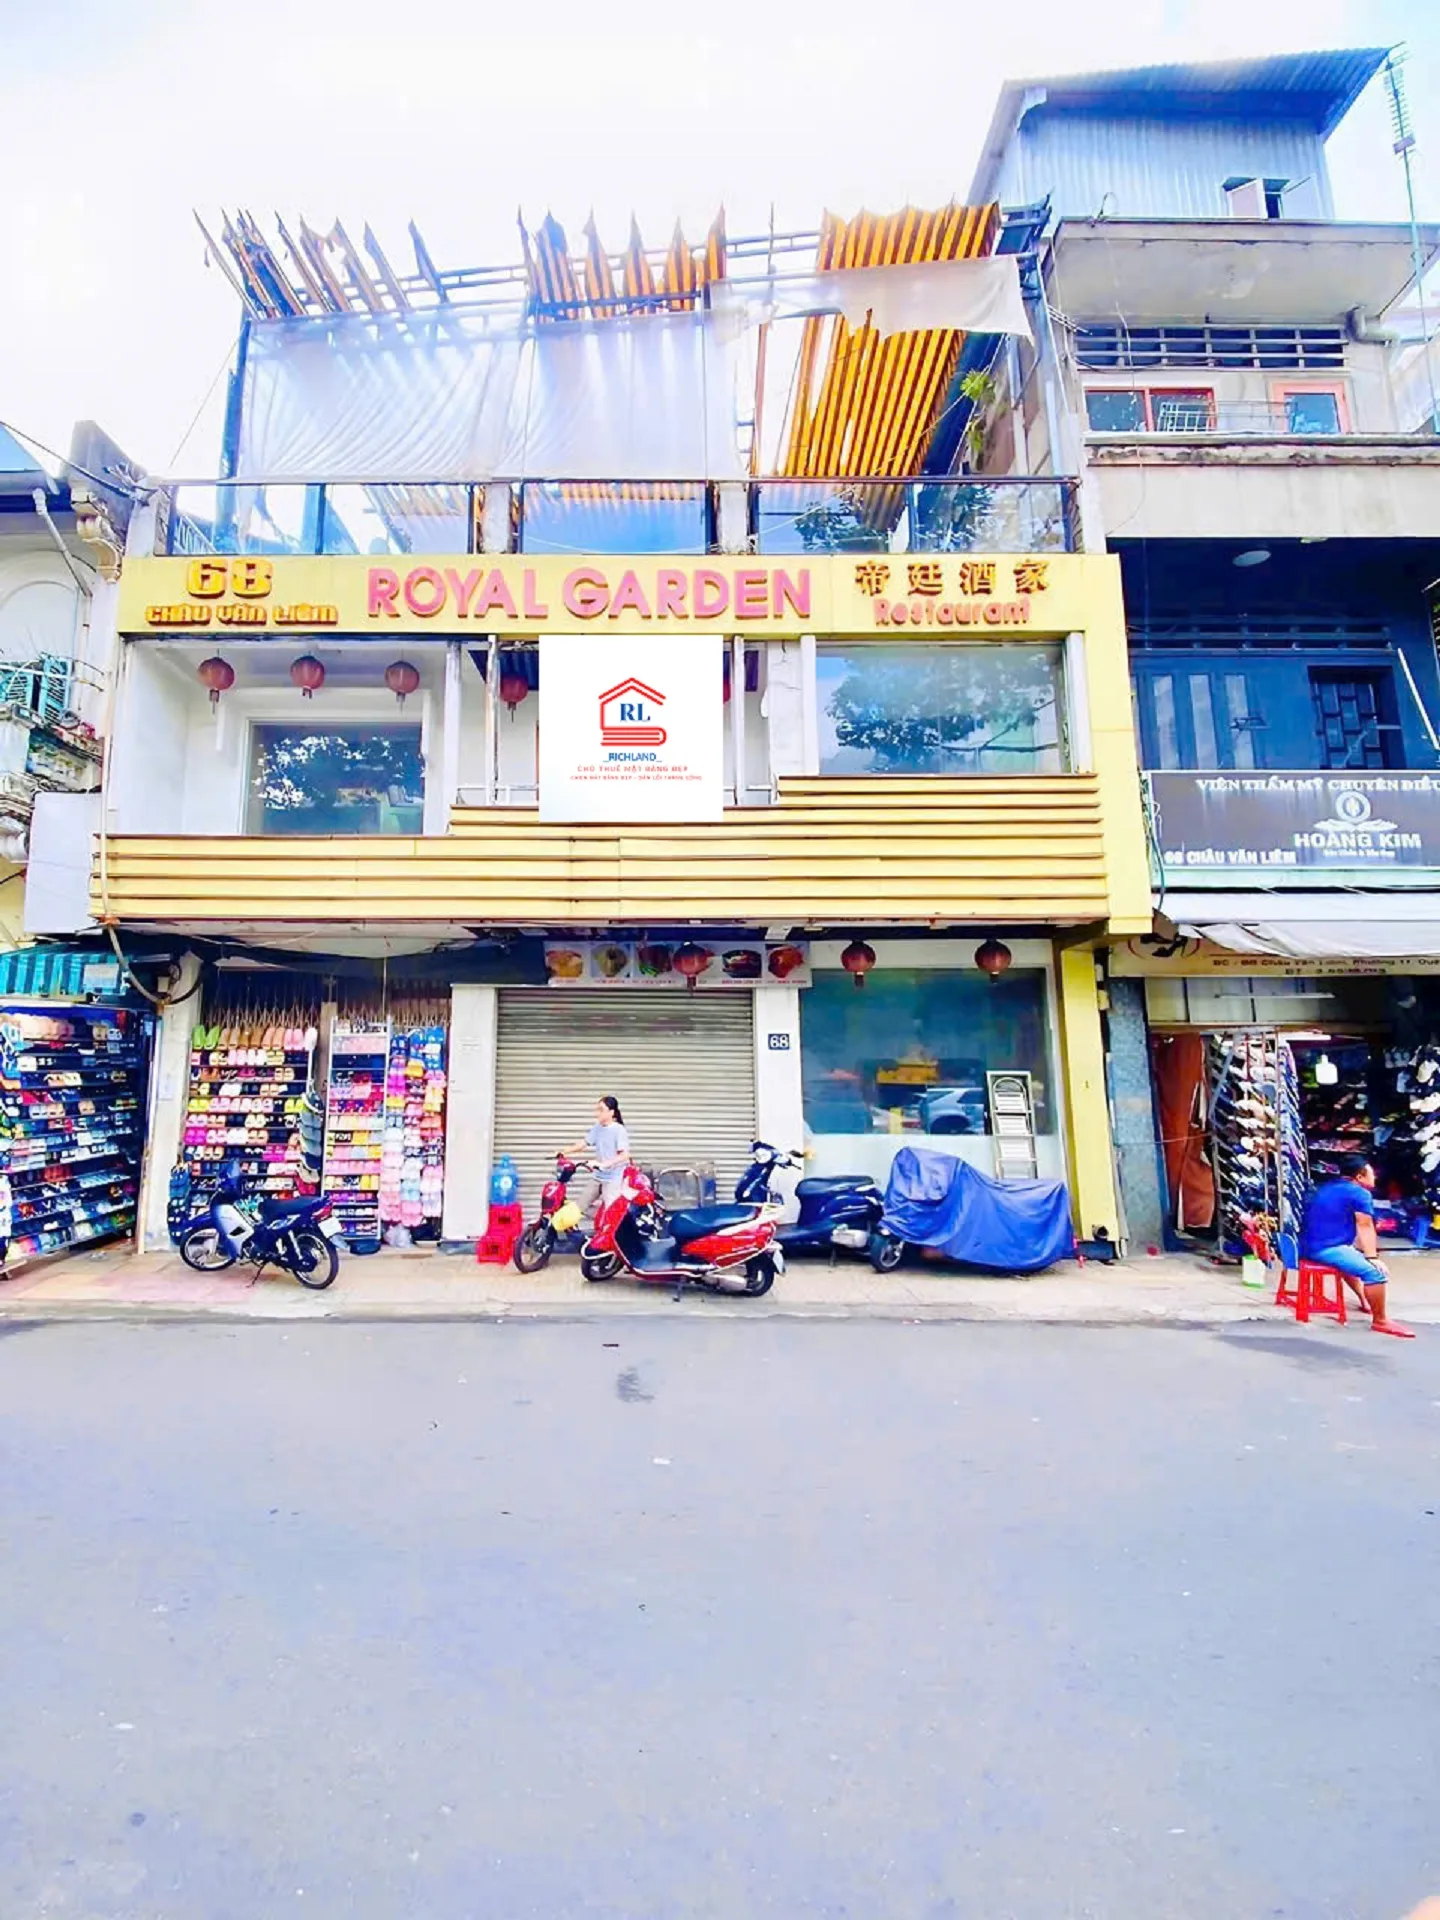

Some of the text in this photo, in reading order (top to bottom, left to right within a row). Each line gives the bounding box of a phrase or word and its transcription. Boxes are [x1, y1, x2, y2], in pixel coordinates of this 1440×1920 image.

[187, 557, 274, 599] 68
[367, 566, 811, 620] ROYAL GARDEN
[874, 597, 1031, 627] Restaurant
[1379, 833, 1422, 849] KIM
